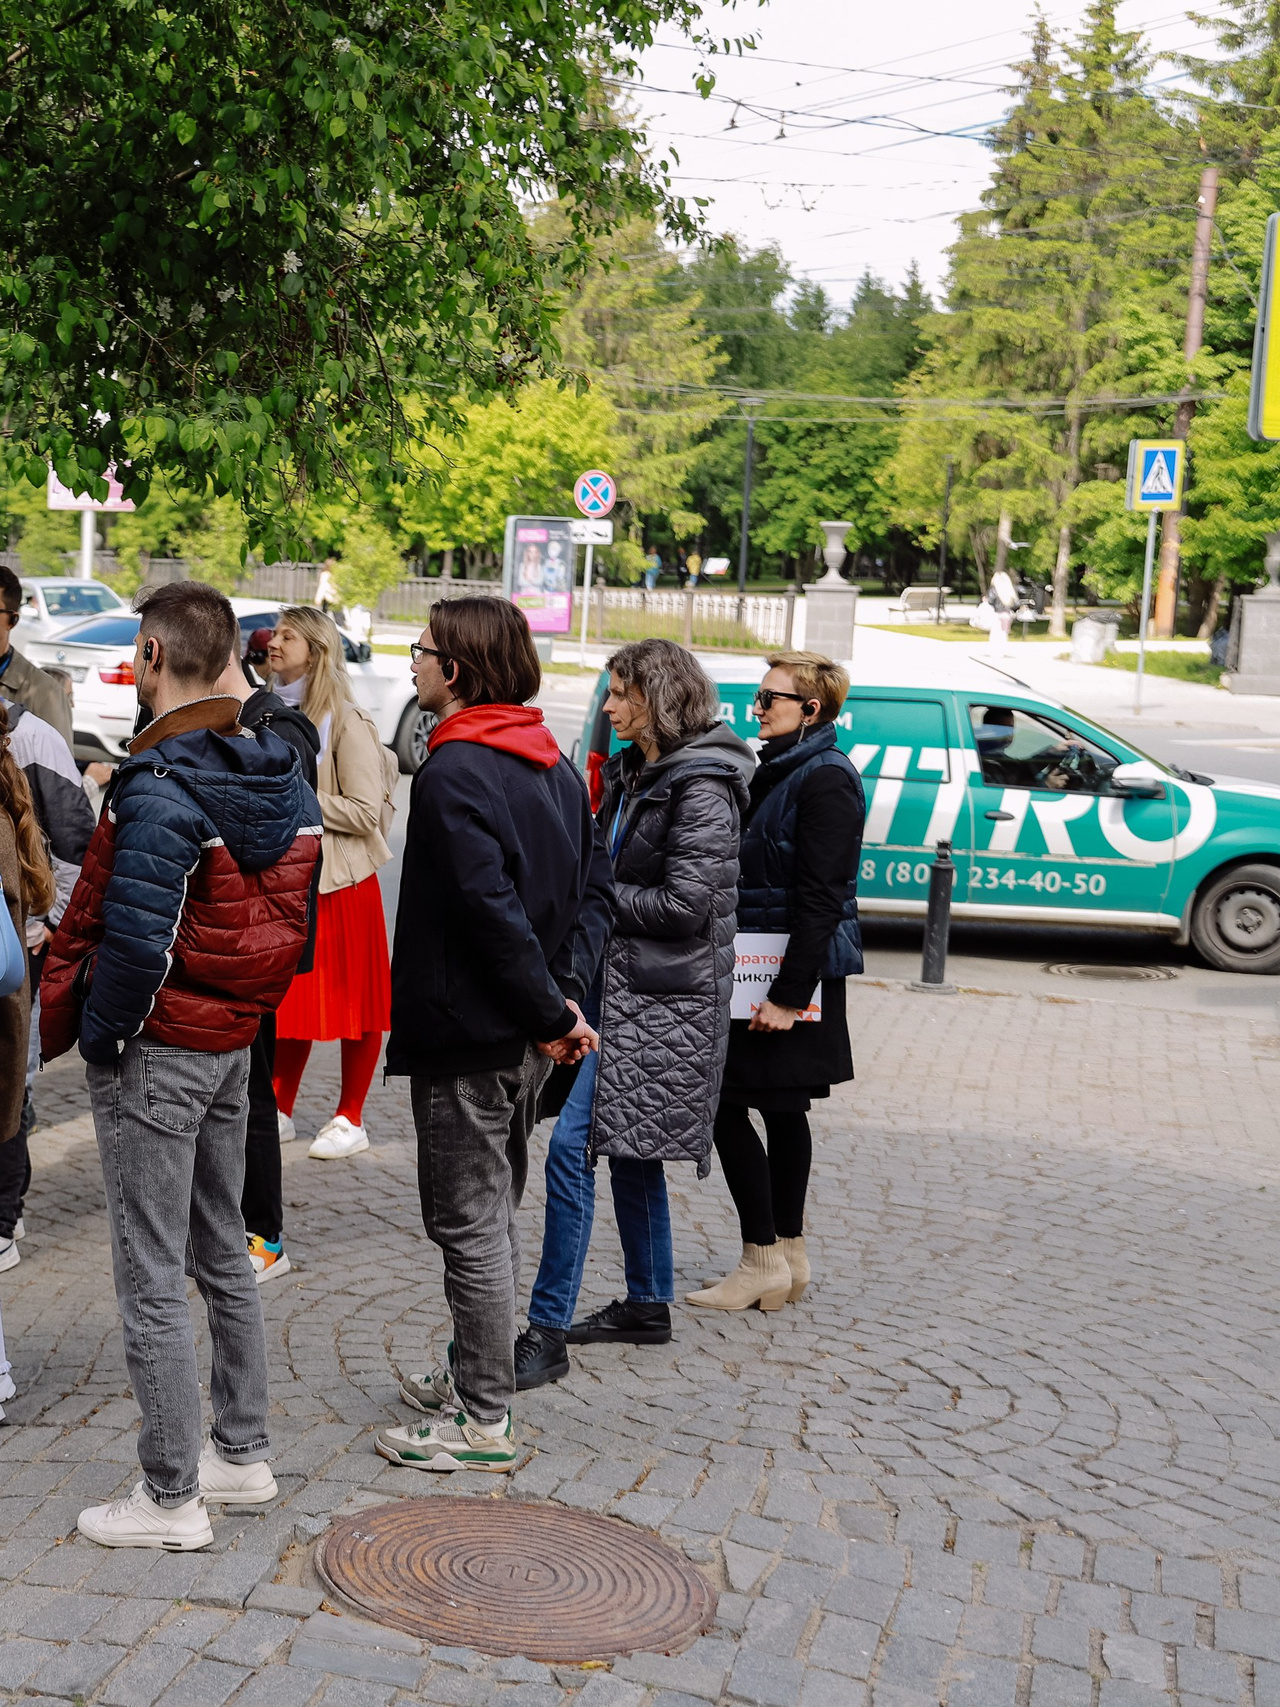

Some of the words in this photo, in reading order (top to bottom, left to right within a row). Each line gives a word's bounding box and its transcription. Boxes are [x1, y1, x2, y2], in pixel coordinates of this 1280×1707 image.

[746, 738, 1217, 863] ITRO
[860, 859, 876, 881] 8
[885, 861, 958, 887] (80)
[967, 866, 1106, 896] 234-40-50
